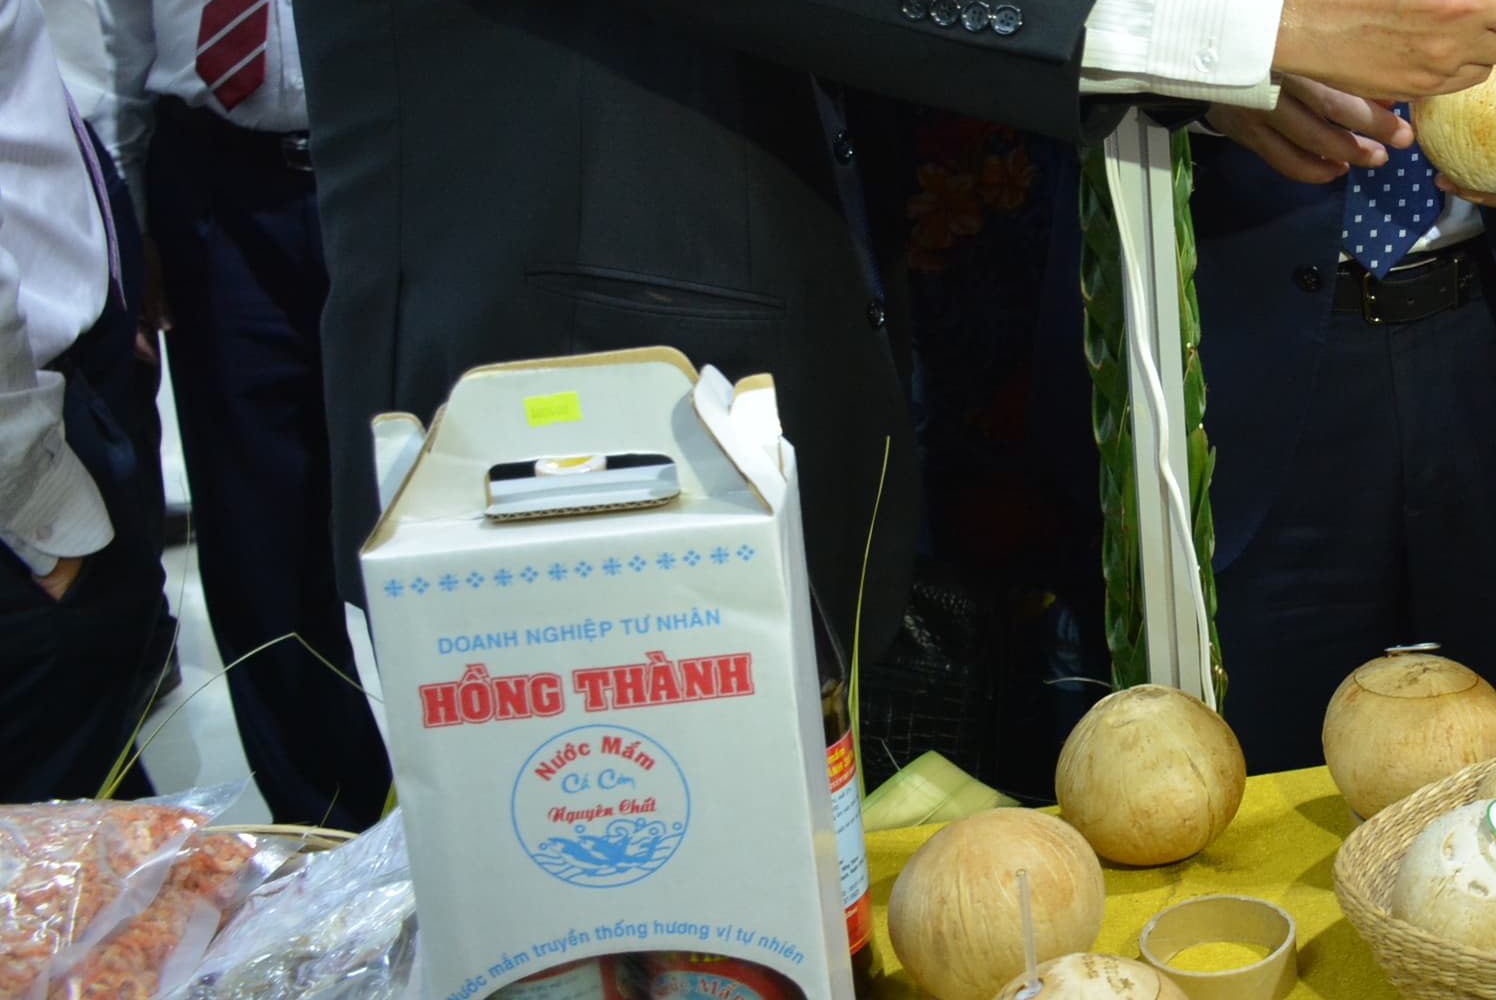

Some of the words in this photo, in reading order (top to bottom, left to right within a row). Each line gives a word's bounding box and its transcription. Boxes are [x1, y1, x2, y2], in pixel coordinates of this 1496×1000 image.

[437, 631, 519, 654] DOANH
[526, 620, 613, 645] NGHIỆP
[619, 615, 651, 635] TƯ
[657, 607, 721, 632] NHÂN
[418, 663, 565, 729] HỒNG
[572, 650, 755, 713] THÀNH
[534, 742, 591, 782] Nước
[601, 735, 656, 771] Mắm
[547, 804, 614, 825] Nguyên
[619, 796, 657, 815] Chất
[594, 919, 648, 941] thống
[653, 919, 711, 941] hương
[716, 924, 732, 943] vị
[736, 927, 756, 945] tự
[757, 935, 806, 965] nhiên
